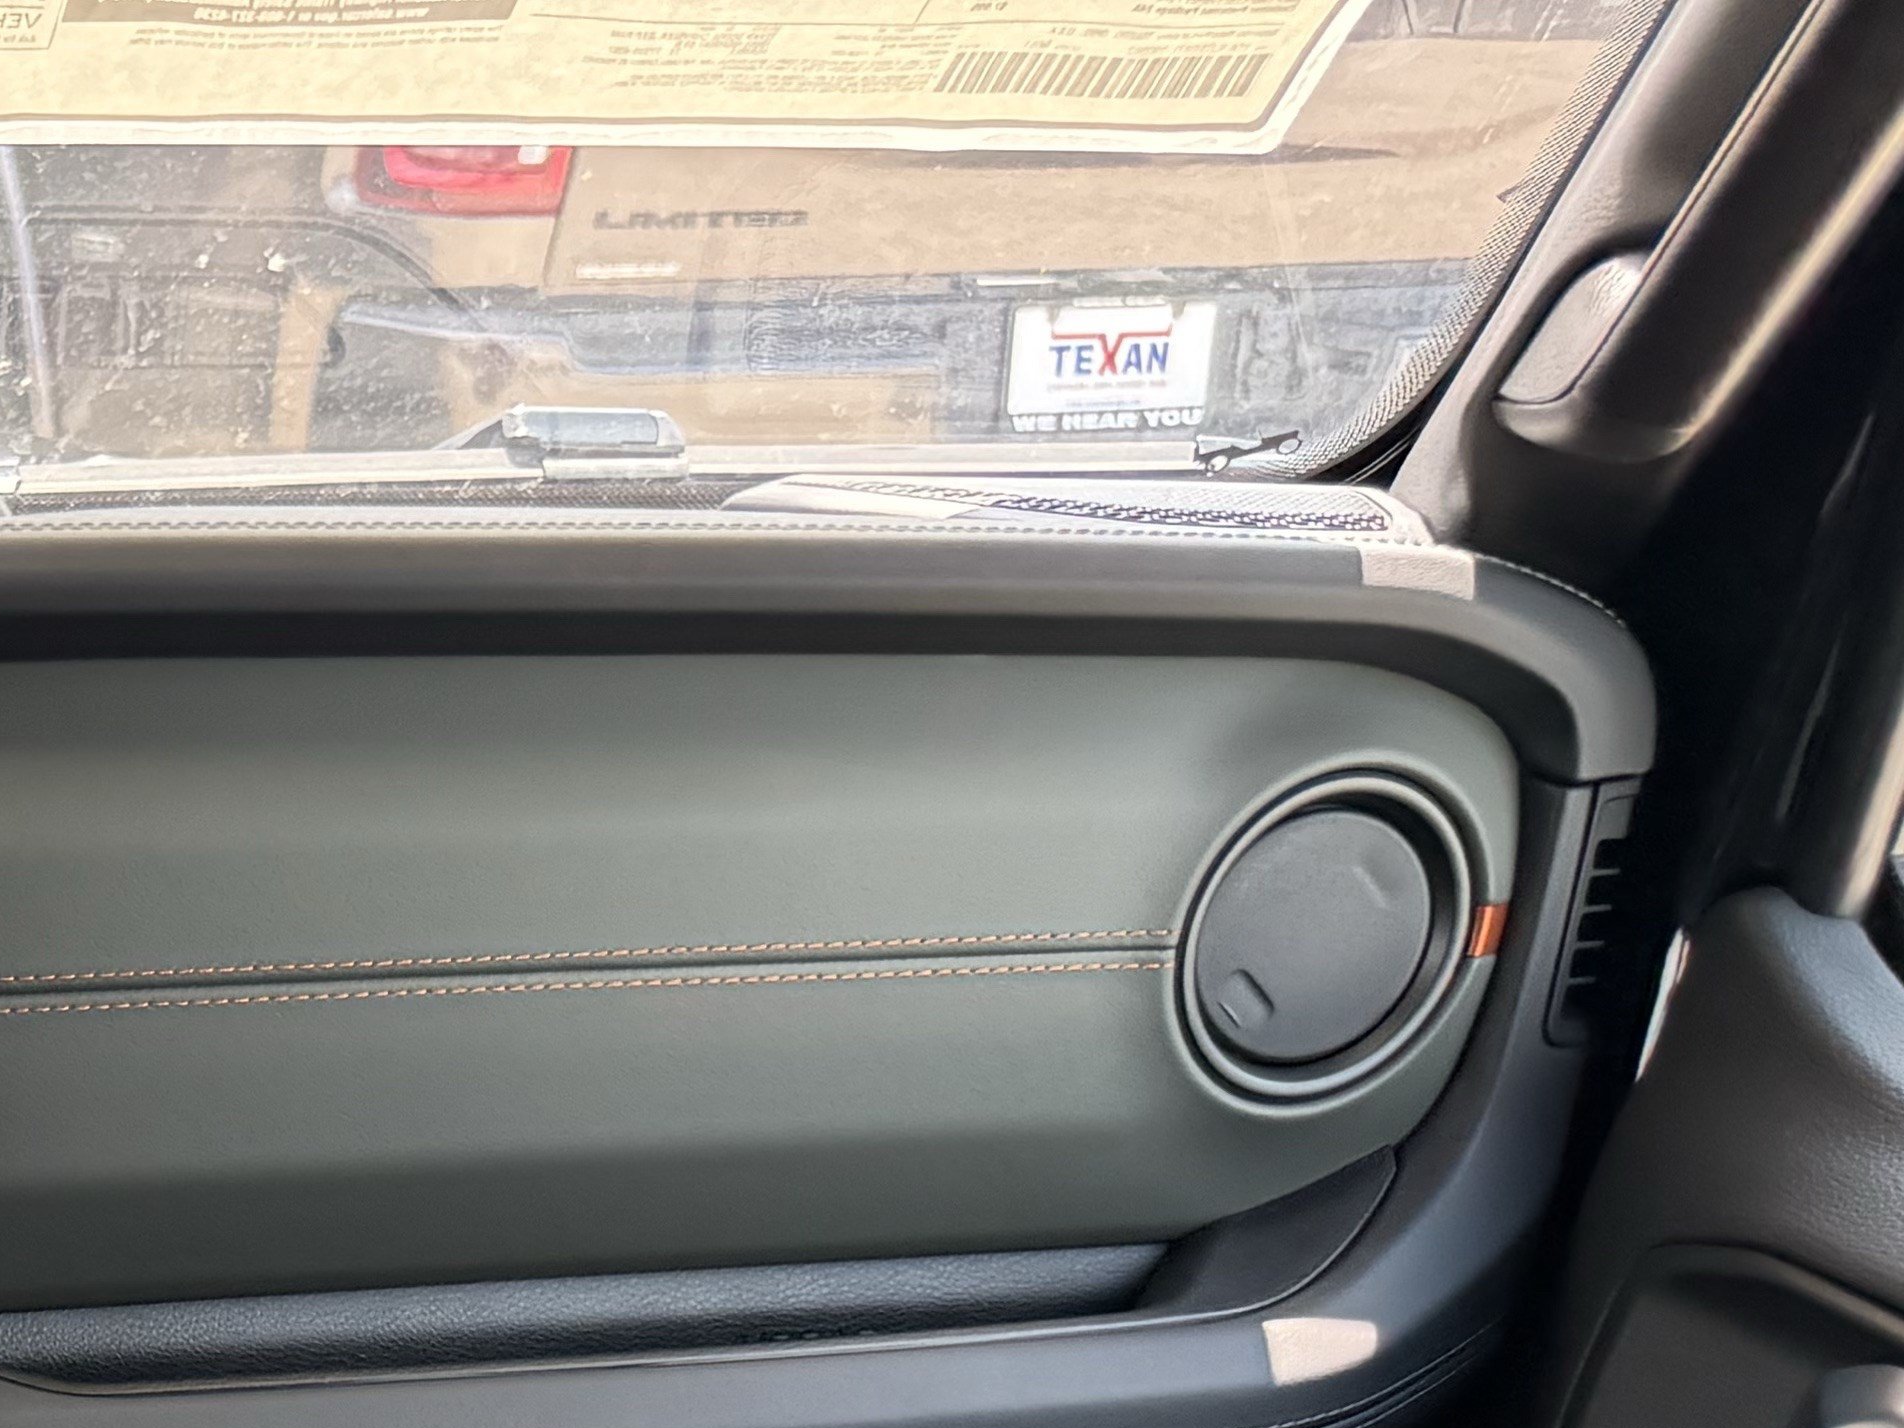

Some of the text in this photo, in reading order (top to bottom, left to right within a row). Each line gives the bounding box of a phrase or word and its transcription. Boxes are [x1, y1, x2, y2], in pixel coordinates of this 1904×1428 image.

[1050, 335, 1171, 377] TEXAN
[1012, 407, 1205, 433] WE HEAR YOU
